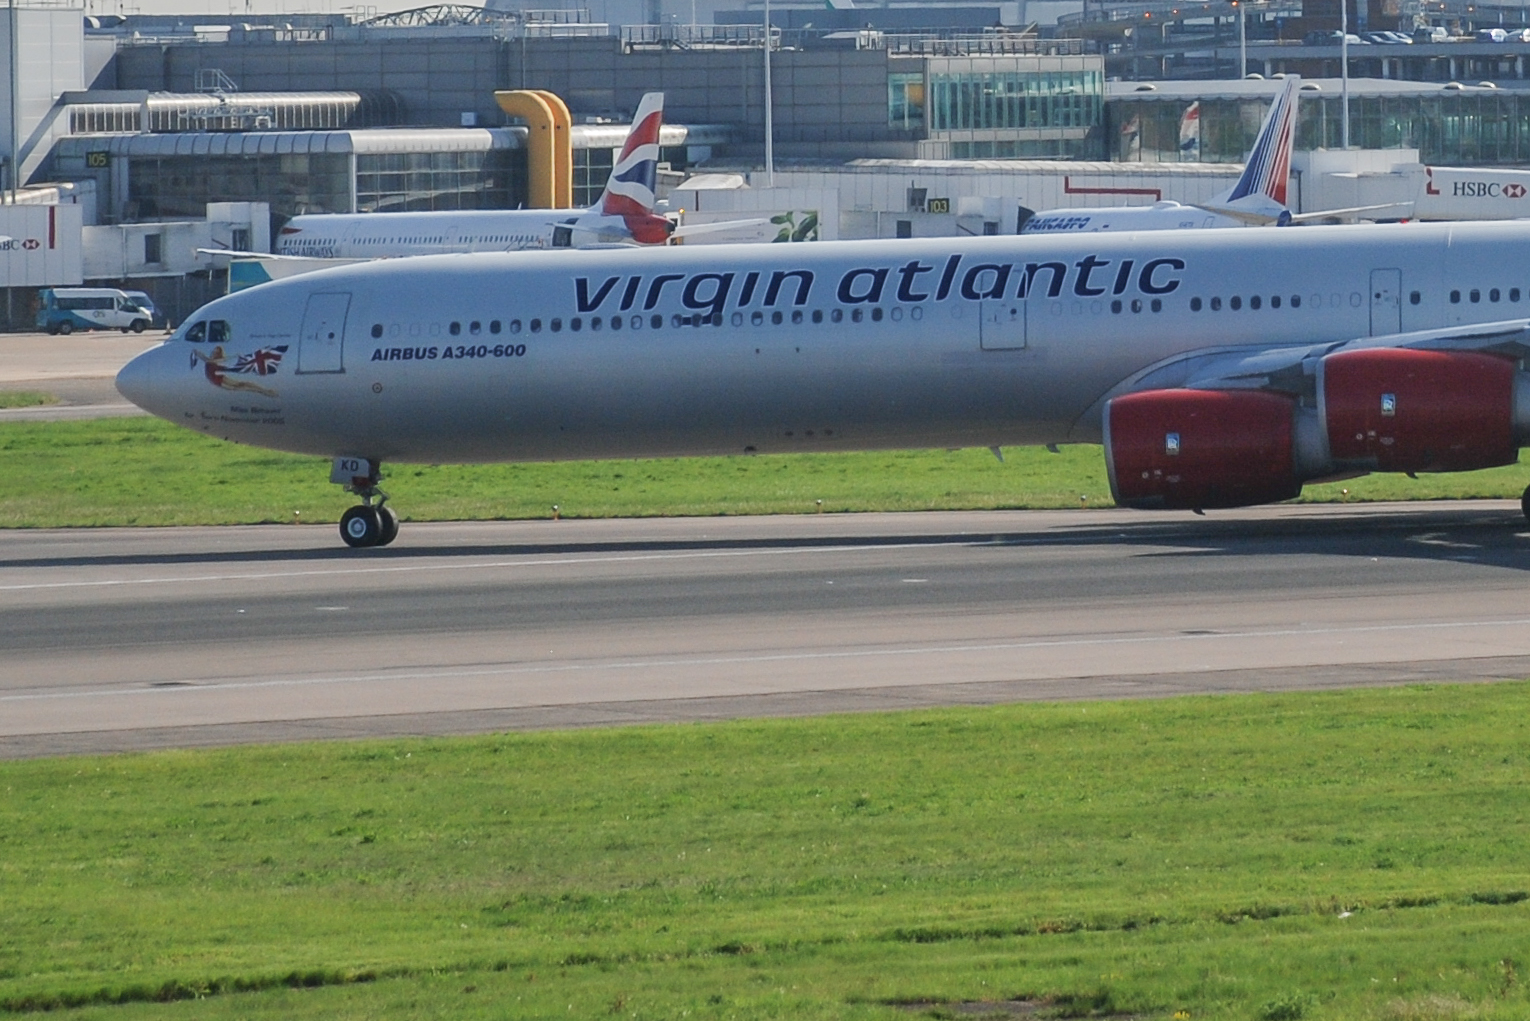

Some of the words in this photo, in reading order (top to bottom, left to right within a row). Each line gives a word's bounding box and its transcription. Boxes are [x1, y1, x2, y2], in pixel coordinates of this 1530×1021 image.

[88, 152, 107, 166] 105
[1453, 182, 1500, 197] HSBC
[930, 200, 947, 213] 103
[574, 270, 815, 326] virgin
[836, 254, 1186, 304] atlantic
[371, 346, 438, 361] AIRBUS
[442, 344, 527, 359] A340-600
[341, 460, 359, 472] KD
